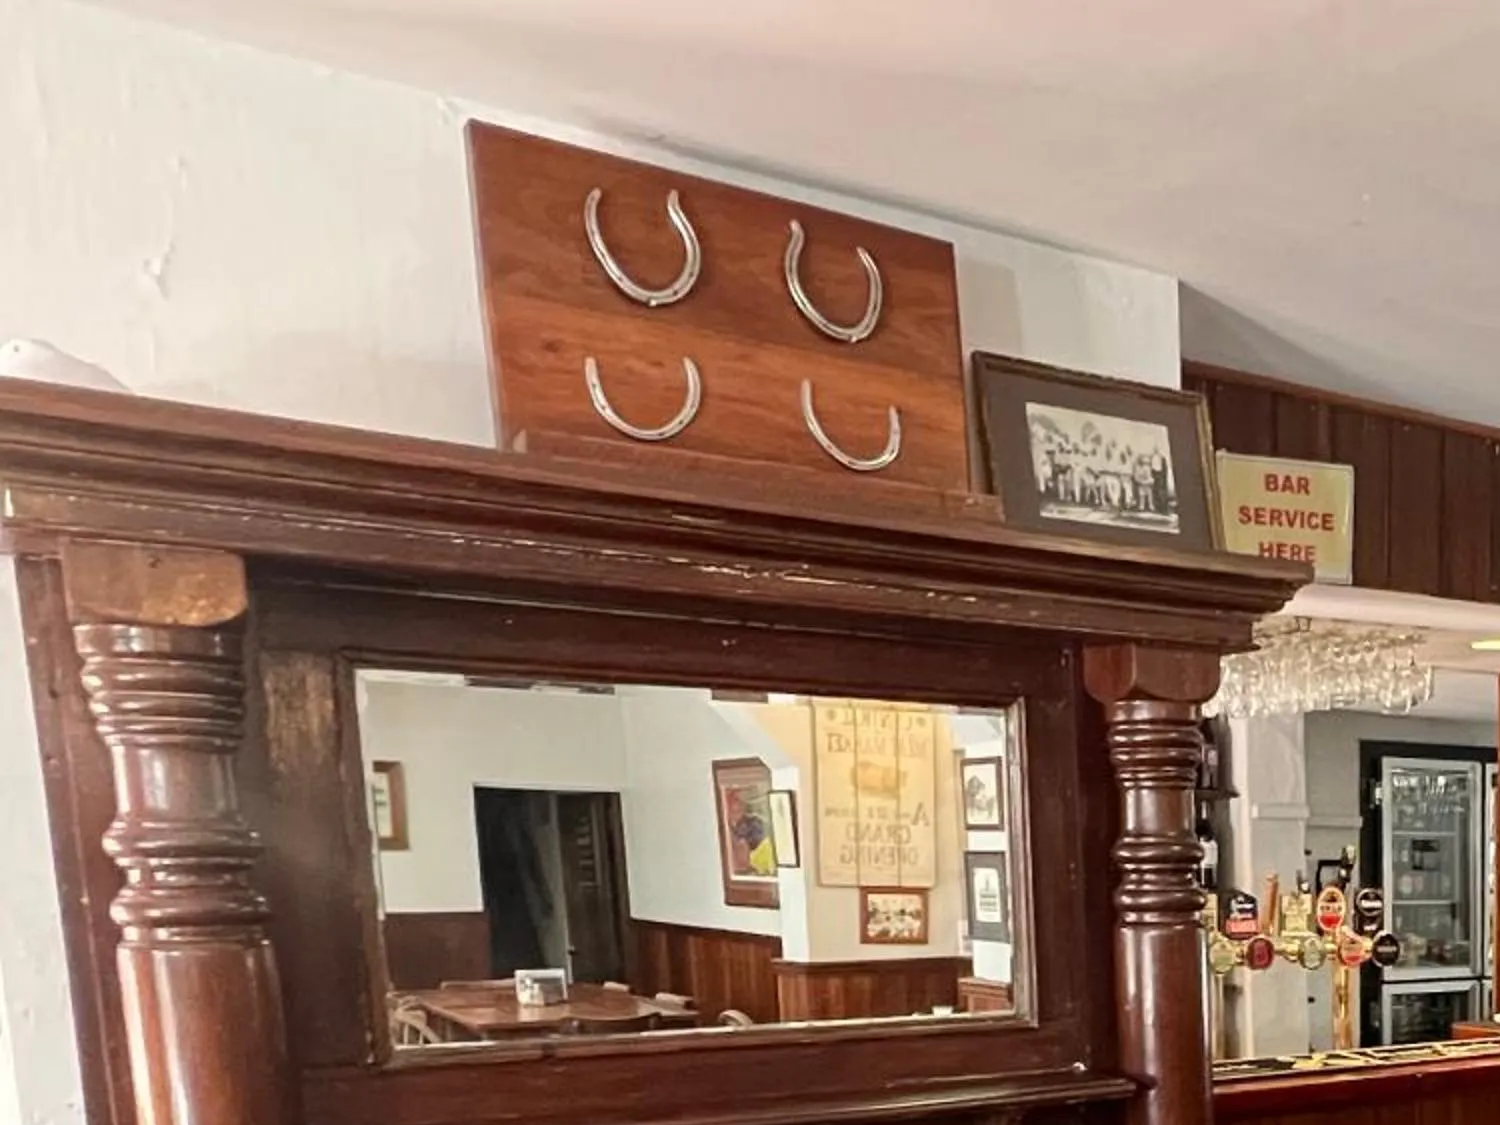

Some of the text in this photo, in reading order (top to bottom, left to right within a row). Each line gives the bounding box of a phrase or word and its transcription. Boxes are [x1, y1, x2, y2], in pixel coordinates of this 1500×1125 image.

[1264, 473, 1310, 496] BAR
[1238, 505, 1335, 531] SERVICE
[1259, 541, 1316, 562] HERE
